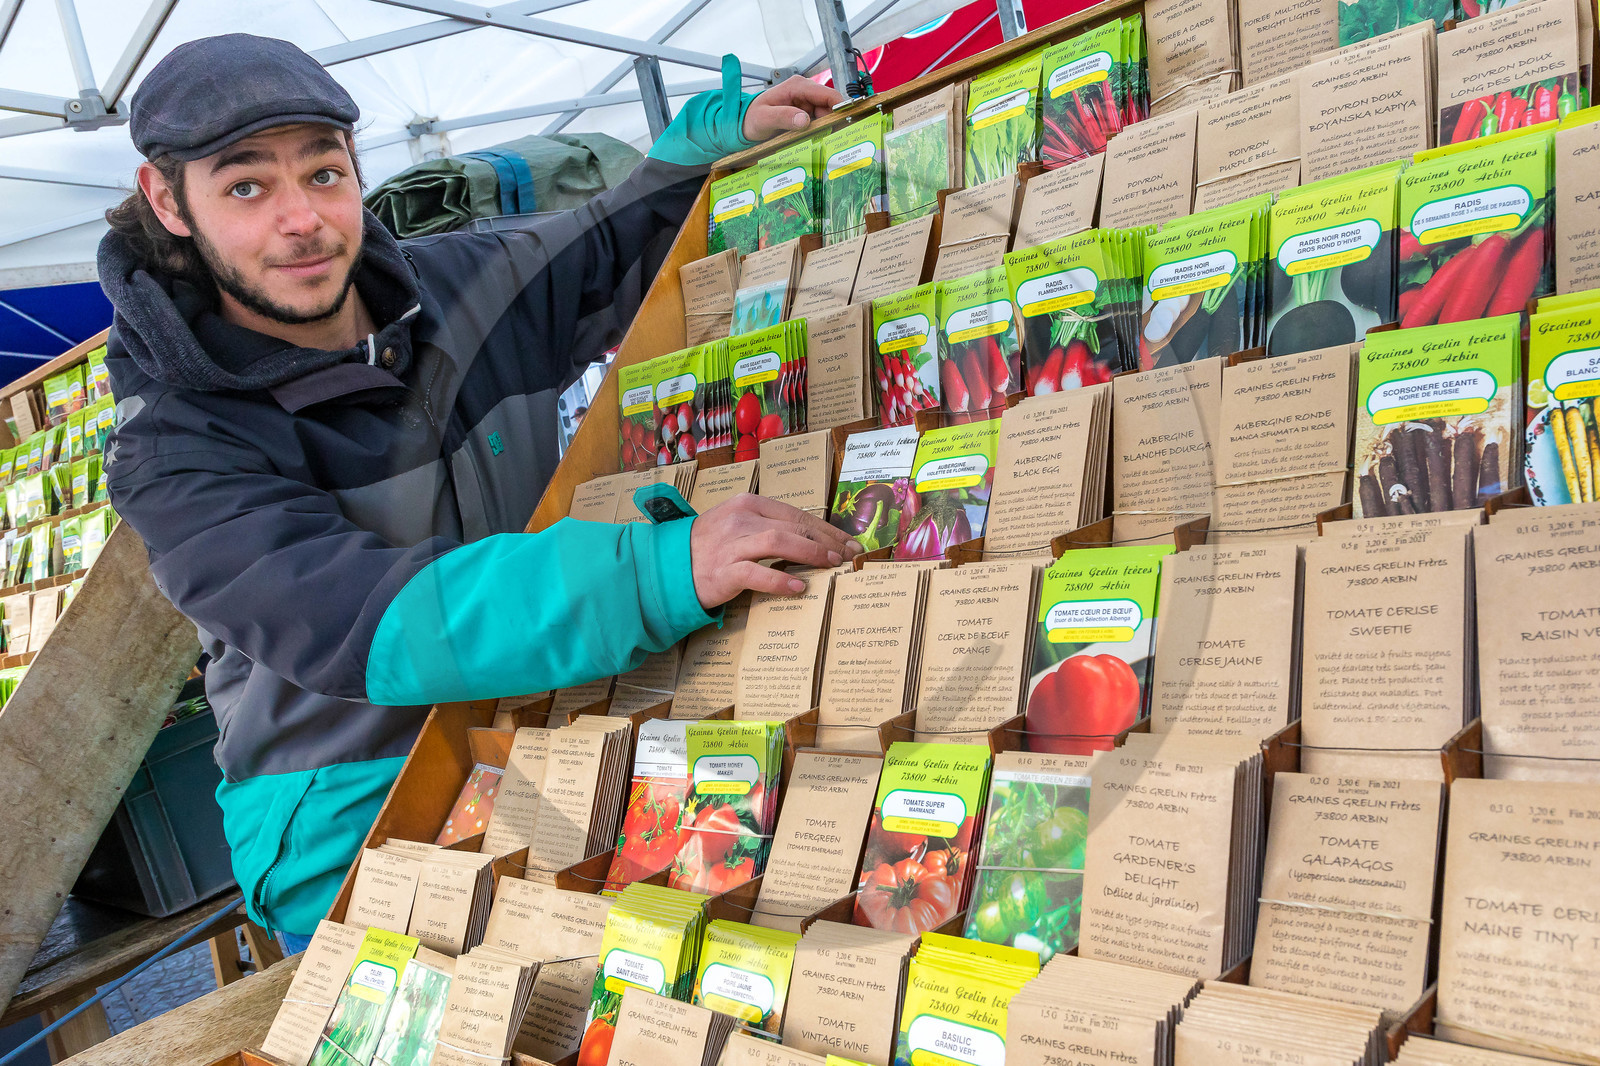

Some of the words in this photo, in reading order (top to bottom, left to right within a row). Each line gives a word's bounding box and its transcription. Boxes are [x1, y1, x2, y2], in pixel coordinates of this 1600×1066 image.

[1256, 17, 1288, 34] BRIGHT
[1288, 7, 1321, 23] LIGHTS
[1156, 29, 1181, 45] POIREE
[1182, 27, 1189, 35] A
[1189, 15, 1215, 32] CARDE
[1173, 34, 1197, 52] JAUNE
[1462, 63, 1516, 84] POIVRON
[1518, 51, 1553, 67] DOUX
[1450, 83, 1484, 99] LONG
[1487, 75, 1511, 89] DES
[1514, 60, 1566, 80] LANDES
[1320, 98, 1369, 117] POIVRON
[1371, 89, 1403, 103] DOUX
[1309, 110, 1372, 133] BOYANSKA
[1374, 99, 1417, 116] KAPIYA
[1228, 139, 1270, 158] POIVRON
[1219, 155, 1254, 173] PURPLE
[1255, 148, 1278, 160] BELL
[1405, 170, 1449, 188] Graines
[1457, 159, 1495, 175] Grelin
[1501, 149, 1537, 164] frères
[1127, 173, 1164, 189] POIVRON
[1428, 178, 1465, 194] 73800
[1475, 169, 1512, 183] Arbin
[1112, 190, 1141, 205] SWEET
[1141, 180, 1179, 196] BANANA
[1454, 198, 1482, 210] RADIS
[1297, 245, 1316, 255] GROS
[1316, 241, 1336, 251] ROND
[1336, 235, 1362, 247] D'HIVER
[1299, 237, 1320, 247] RADIS
[1321, 233, 1339, 243] NOIR
[1340, 228, 1361, 239] ROND
[1174, 265, 1193, 274] RADIS
[1194, 261, 1210, 270] NOIR
[1038, 284, 1069, 296] FLAMBOYANT
[1045, 279, 1063, 289] RADIS
[970, 309, 988, 319] RADIS
[1566, 366, 1599, 377] BLANC
[1383, 382, 1440, 398] SCORSONERE
[1441, 378, 1478, 388] GEANTE
[1398, 392, 1420, 401] NOIRE
[1432, 387, 1460, 396] RUSSIE
[1233, 415, 1292, 431] AUBERGINE
[1294, 409, 1332, 422] RONDE
[1138, 429, 1194, 447] AUBERGINE
[1230, 433, 1259, 443] BIANCA
[1259, 427, 1300, 439] SFUMATA
[1310, 422, 1335, 431] ROSA
[1013, 452, 1063, 466] AUBERGINE
[1123, 448, 1168, 463] BLANCHE
[1169, 441, 1212, 456] DOURGA
[937, 461, 967, 470] AUBERGINE
[1013, 468, 1040, 479] BLACK
[1041, 465, 1060, 475] EGG
[864, 474, 876, 482] BLACK
[1341, 542, 1353, 550] 0,5
[1365, 539, 1381, 548] 3,20
[1395, 536, 1408, 545] Fin
[1408, 534, 1426, 544] 2021
[1321, 564, 1371, 576] GRAINES
[1373, 561, 1416, 572] GRELIN
[1418, 558, 1448, 568] Frères
[1347, 577, 1379, 588] 73800
[1381, 575, 1418, 584] ARBIN
[1054, 609, 1079, 617] TOMATE
[1080, 608, 1101, 616] CŒUR
[1112, 607, 1133, 615] BŒUF
[1326, 607, 1383, 619] TOMATE
[1386, 604, 1439, 617] CERISE
[956, 617, 993, 627] TOMATE
[767, 629, 795, 638] TOMATE
[836, 627, 865, 636] TOMATE
[865, 626, 904, 635] OXHEART
[937, 633, 966, 642] CŒUR
[967, 632, 979, 640] DE
[980, 631, 1010, 640] BŒUF
[1349, 624, 1412, 637] SWEETIE
[1520, 629, 1579, 642] RAISIN
[706, 638, 730, 646] TOMATE
[758, 642, 800, 650] COSTOLUTO
[835, 640, 867, 650] ORANGE
[867, 639, 900, 648] STRIPED
[1197, 639, 1246, 650] TOMATE
[952, 645, 991, 656] ORANGE
[756, 654, 798, 663] FIORENTINO
[1179, 656, 1223, 669] CERISE
[1222, 656, 1263, 669] JAUNE
[558, 777, 577, 786] TOMATE
[903, 798, 925, 807] TOMATE
[925, 800, 945, 809] SUPER
[908, 807, 936, 815] MARMANDE
[805, 818, 837, 829] TOMATE
[794, 831, 841, 843] EVERGREEN
[1128, 835, 1180, 852] TOMATE
[1319, 836, 1379, 851] TOMATE
[1113, 852, 1196, 874] GARDENER'S
[1302, 854, 1394, 872] GALAPAGOS
[1124, 872, 1180, 890] DELIGHT
[369, 897, 392, 908] TOMATE
[1103, 884, 1133, 901] (Délice
[1135, 891, 1149, 906] du
[1148, 896, 1200, 913] jardinier)
[1464, 896, 1543, 917] TOMATE
[427, 919, 448, 930] TOMATE
[415, 929, 430, 938] ROSE
[429, 932, 437, 940] DE
[437, 933, 455, 944] BERNE
[1464, 921, 1523, 939] NAINE
[1533, 929, 1579, 952] TINY
[624, 958, 644, 971] TOMATE
[615, 967, 631, 977] SAINT
[629, 971, 649, 983] PIERRE
[449, 1003, 469, 1015] SALVIA
[817, 1015, 856, 1033] TOMATE
[801, 1030, 842, 1048] VINTAGE
[843, 1039, 869, 1054] WINE
[941, 1031, 972, 1046] BASILIC
[934, 1039, 958, 1052] GRAND
[959, 1046, 977, 1057] VERT
